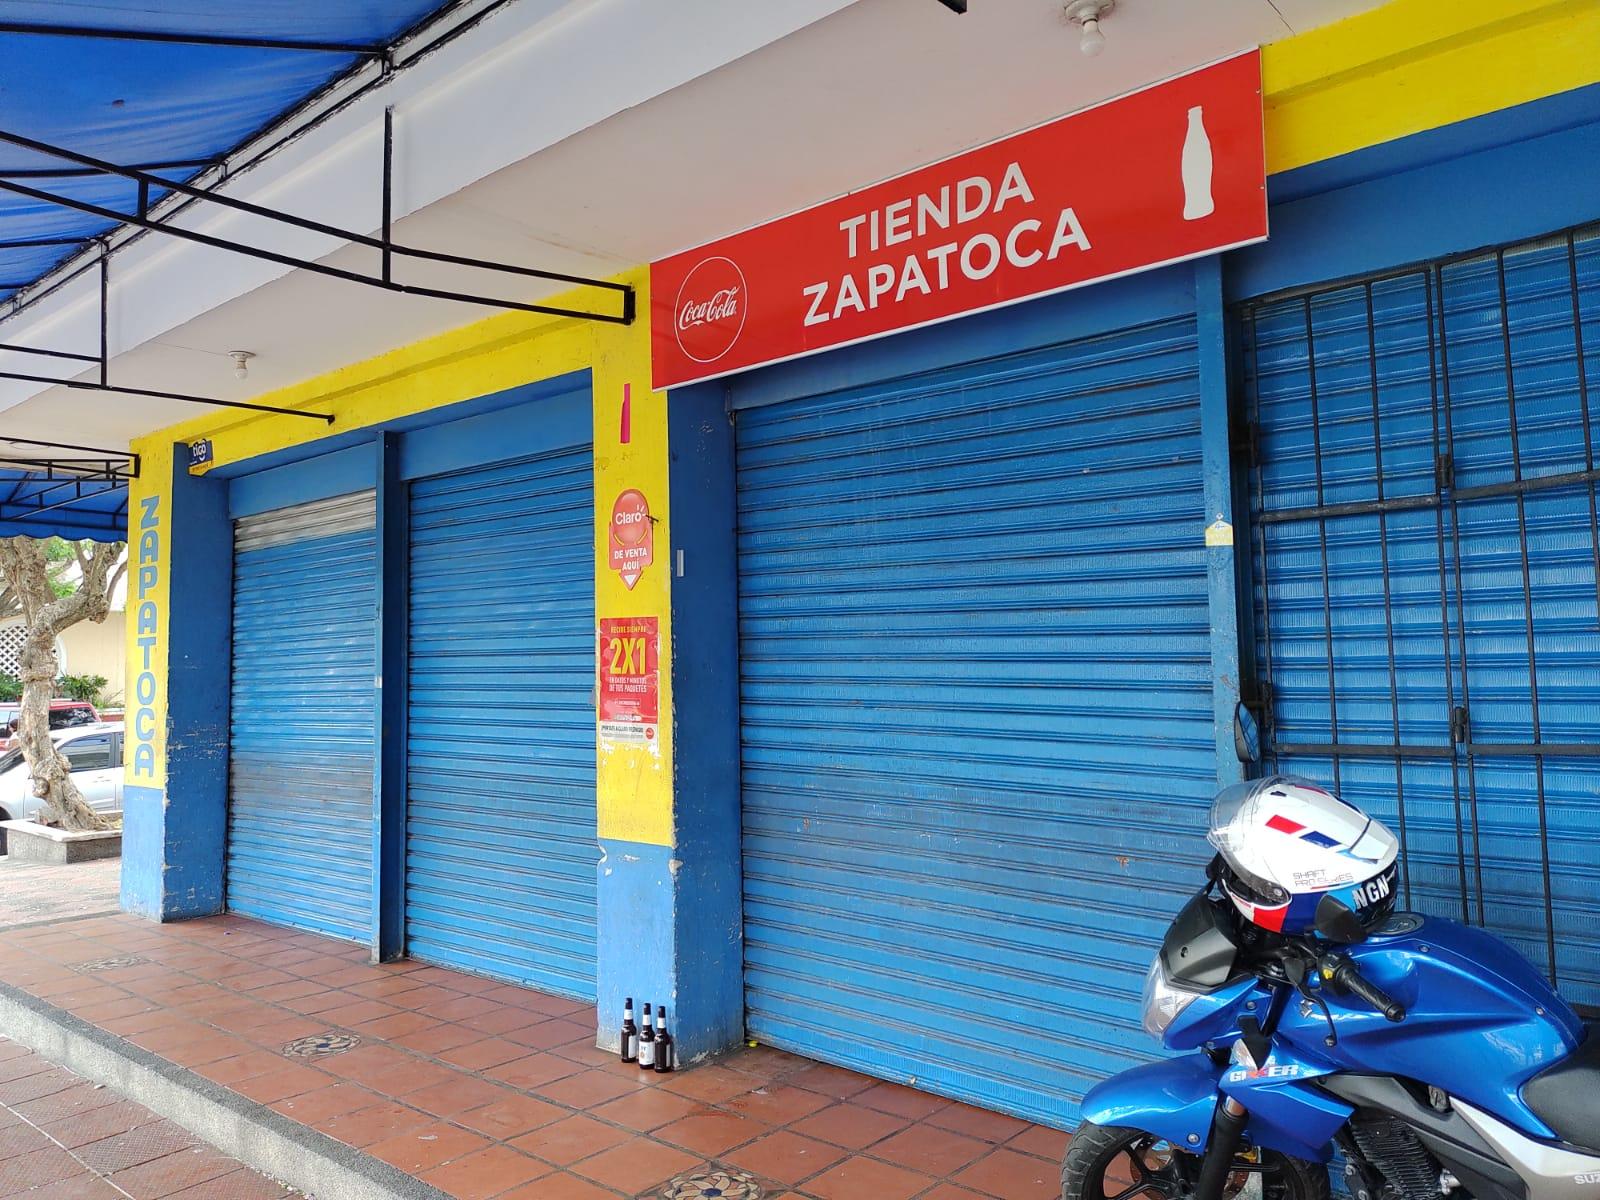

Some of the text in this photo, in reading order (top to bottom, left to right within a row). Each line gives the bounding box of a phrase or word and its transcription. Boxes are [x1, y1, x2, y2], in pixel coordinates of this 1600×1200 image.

[839, 162, 1035, 258] TIENDA
[803, 207, 1092, 327] ZAPATOCA
[679, 286, 740, 330] Coca-Cola
[615, 508, 643, 525] Claro
[614, 547, 648, 559] DE VENTA
[134, 494, 161, 778] ZAPATOCA
[609, 637, 646, 675] 2X1
[1352, 874, 1390, 910] NGN
